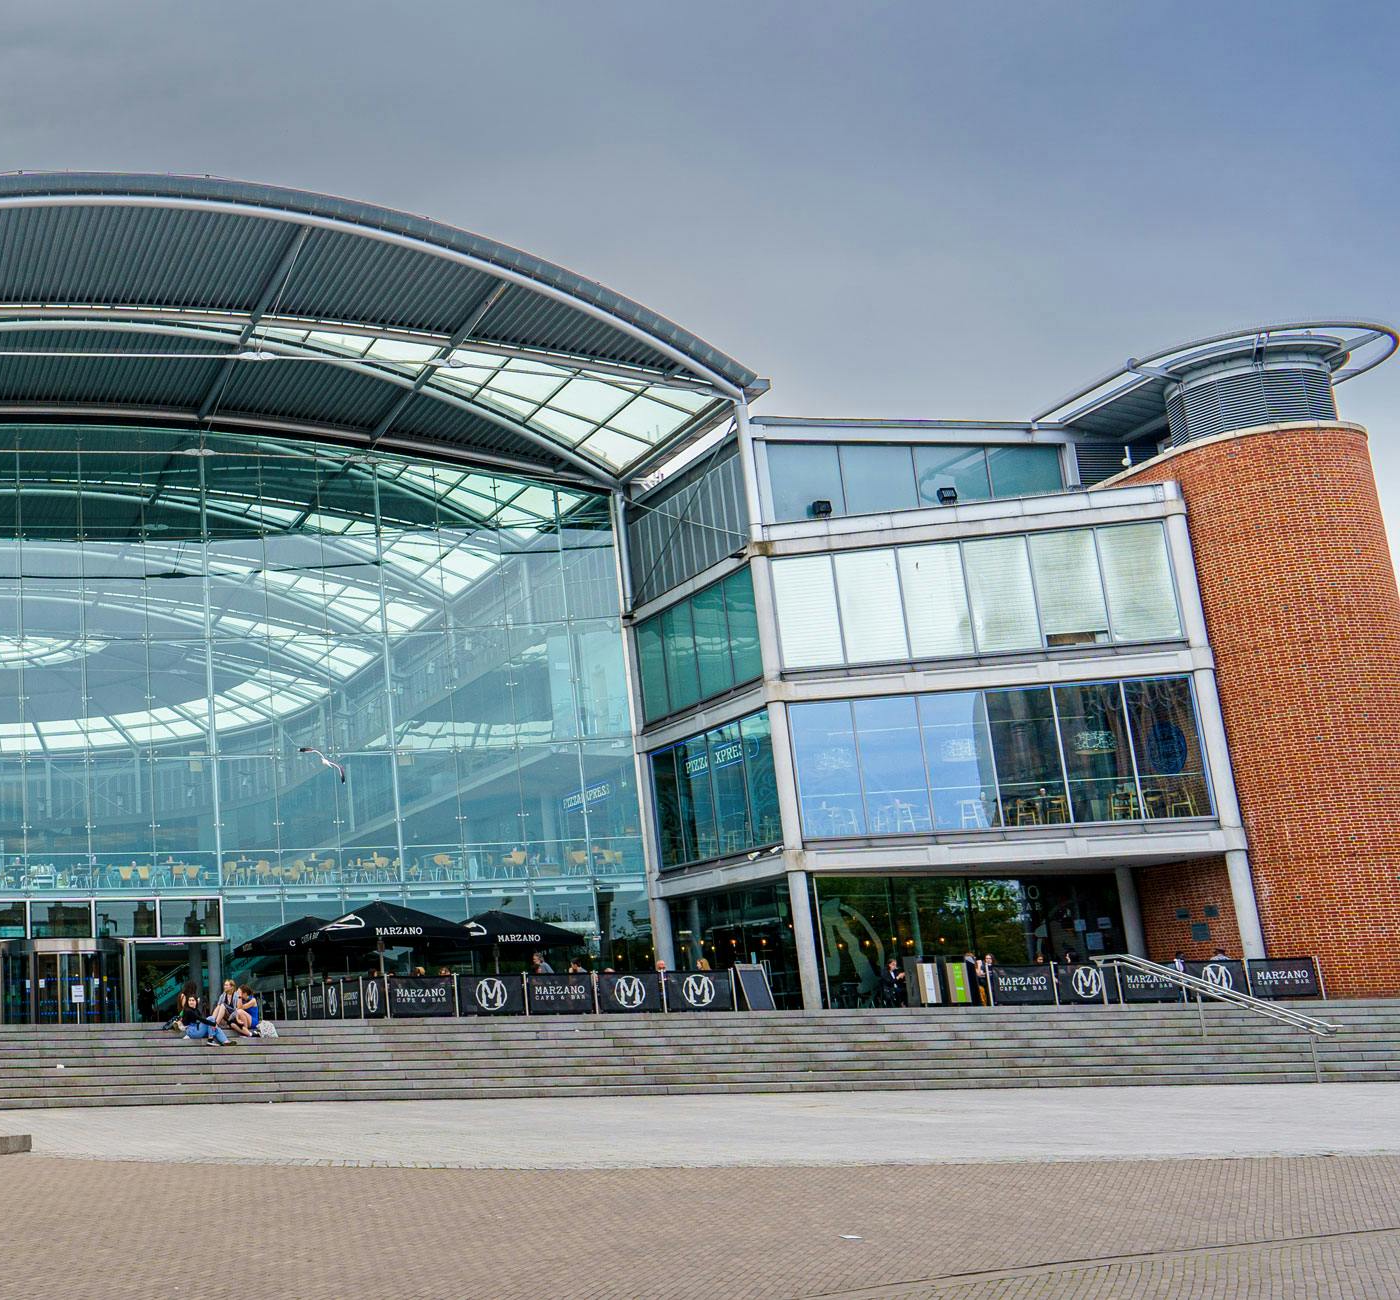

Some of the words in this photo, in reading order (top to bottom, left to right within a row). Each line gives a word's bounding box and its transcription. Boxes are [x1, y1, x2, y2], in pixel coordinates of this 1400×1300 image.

[948, 885, 1040, 901] MRZANO
[375, 927, 422, 936] MARZANO
[497, 934, 541, 943] MARZANO
[1256, 970, 1309, 980] MARZANO
[999, 977, 1047, 986] MARZANO
[1076, 968, 1100, 995] M
[396, 988, 446, 998] MARZANO
[479, 979, 505, 1008] M
[535, 985, 585, 995] MARZANO
[617, 977, 643, 1006] M
[685, 976, 713, 1004] M
